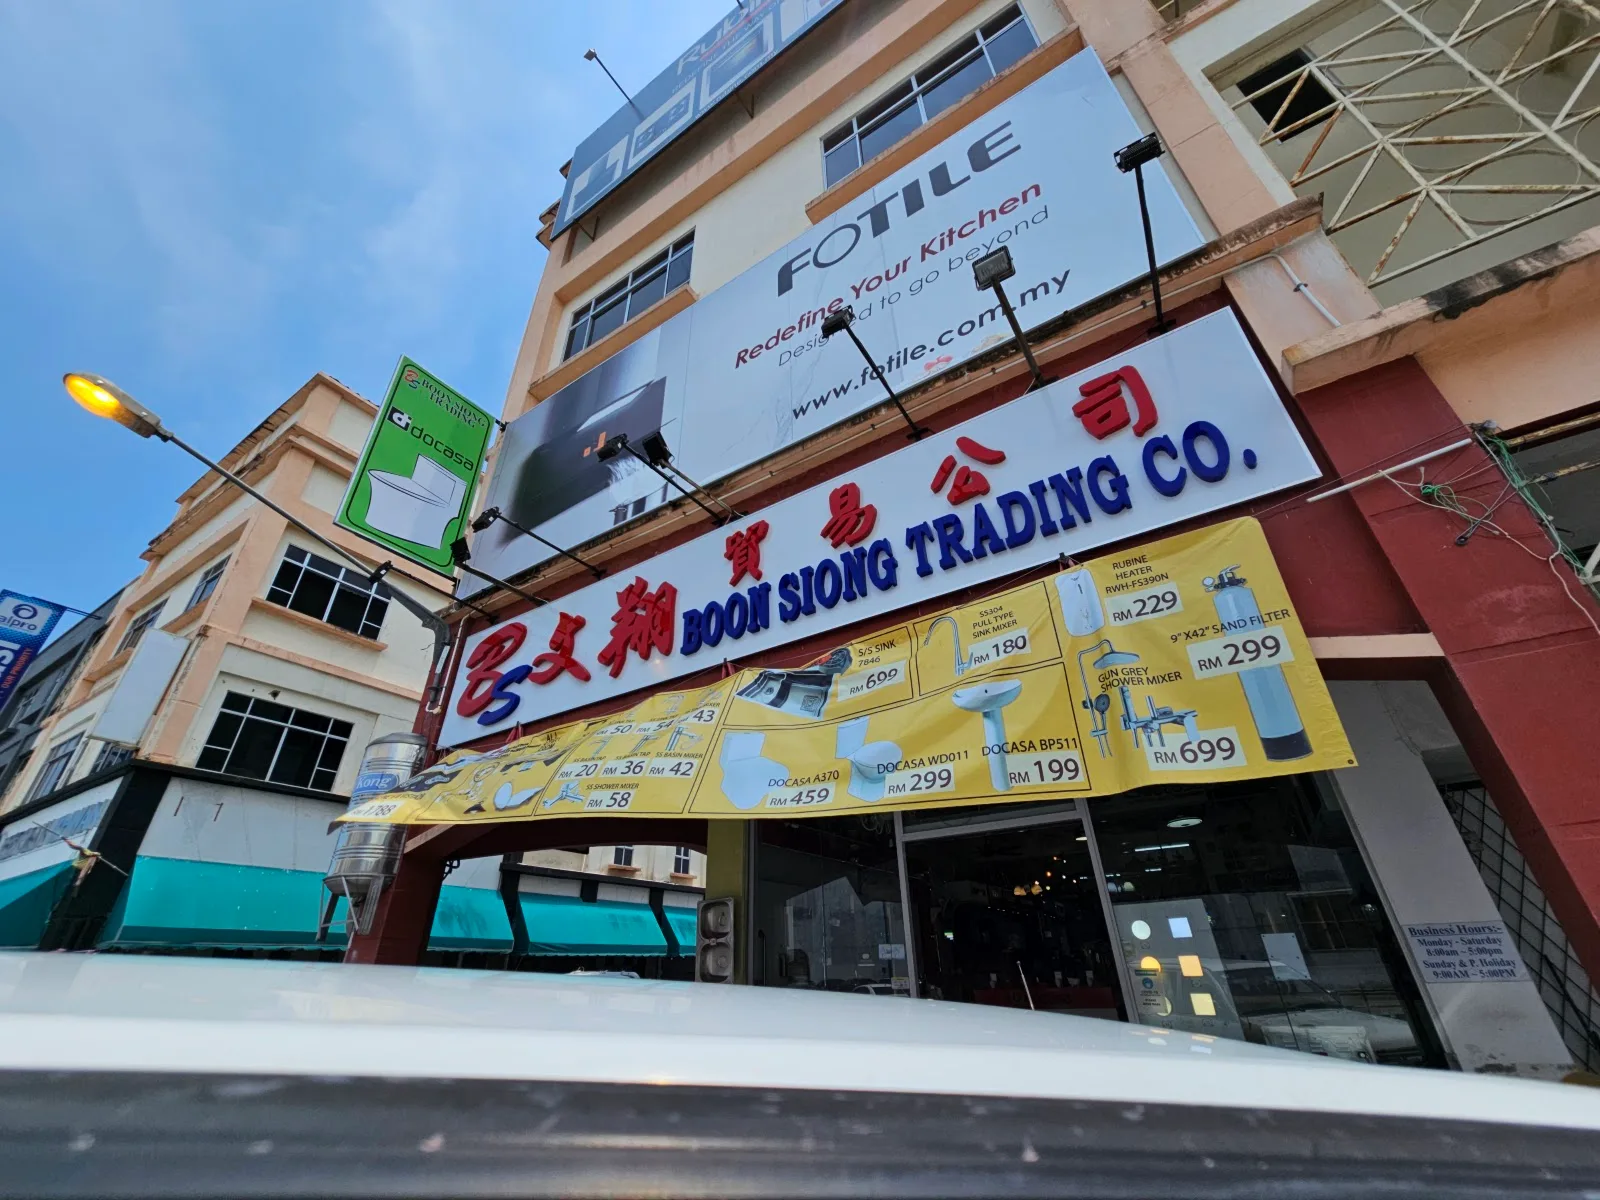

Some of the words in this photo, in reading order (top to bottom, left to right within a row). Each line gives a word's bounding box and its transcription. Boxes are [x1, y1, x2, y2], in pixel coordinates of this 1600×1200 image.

[778, 120, 1021, 297] FOTILE
[735, 297, 843, 369] Redefine
[850, 255, 911, 300] Your
[920, 183, 1041, 263] Kitchen
[778, 303, 872, 367] Desigd
[880, 291, 901, 310] to
[909, 270, 940, 296] go
[949, 204, 1049, 272] beyond
[793, 269, 1070, 420] www.fotile.com.my
[421, 378, 452, 403] BOON
[410, 425, 474, 471] docasa
[680, 580, 771, 656] BOON
[778, 537, 898, 623] SIONG
[905, 454, 1133, 578] TRADING
[1142, 420, 1258, 498] CO.
[1112, 554, 1149, 571] RUBINE
[1115, 565, 1153, 581] HEATER
[1105, 572, 1170, 595] RWH-FS390N
[979, 605, 1003, 618] SS304
[1113, 609, 1133, 622] RM
[1132, 589, 1178, 618] 229
[972, 616, 994, 629] PULL
[995, 611, 1014, 623] TYPE
[972, 627, 991, 639] SINK
[992, 619, 1018, 634] MIXER
[1212, 617, 1248, 635] SAND
[1248, 607, 1291, 627] FILTER
[858, 647, 873, 657] S/S
[875, 639, 897, 654] SINK
[973, 655, 990, 665] RM
[992, 635, 1027, 658] 180
[1198, 657, 1223, 672] RM
[1222, 634, 1282, 667] 299
[858, 655, 881, 667] 7846
[849, 684, 864, 695] RM
[866, 667, 898, 690] 699
[1097, 667, 1119, 684] GUN
[1120, 666, 1149, 678] GREY
[1100, 675, 1145, 693] SHOWER
[1149, 670, 1183, 686] MIXER
[653, 719, 674, 732] 54
[693, 709, 715, 722] 43
[610, 725, 633, 734] 50
[981, 739, 1037, 757] DOCASA
[1040, 737, 1078, 751] BP511
[1154, 751, 1178, 764] RM
[1179, 736, 1236, 764] 699
[558, 771, 573, 779] RM
[574, 763, 598, 777] 20
[602, 766, 617, 775] RM
[620, 760, 645, 775] 36
[649, 766, 665, 775] RM
[669, 761, 694, 776] 42
[877, 760, 925, 775] DOCASA
[927, 750, 969, 767] WD011
[1009, 771, 1030, 784] RM
[1033, 758, 1080, 783] 199
[768, 776, 811, 788] DOCASA
[813, 769, 840, 784] A370
[888, 783, 906, 795] RM
[909, 768, 952, 792] 299
[587, 799, 603, 808] RM
[606, 791, 631, 807] 58
[769, 797, 787, 806] RM
[789, 787, 830, 805] 459
[1408, 925, 1455, 936] Business
[1417, 938, 1453, 948] Monday
[1462, 937, 1502, 946] Saturday
[1423, 960, 1457, 969] Sunday
[1459, 959, 1467, 967] &
[1480, 958, 1516, 968] Holiday
